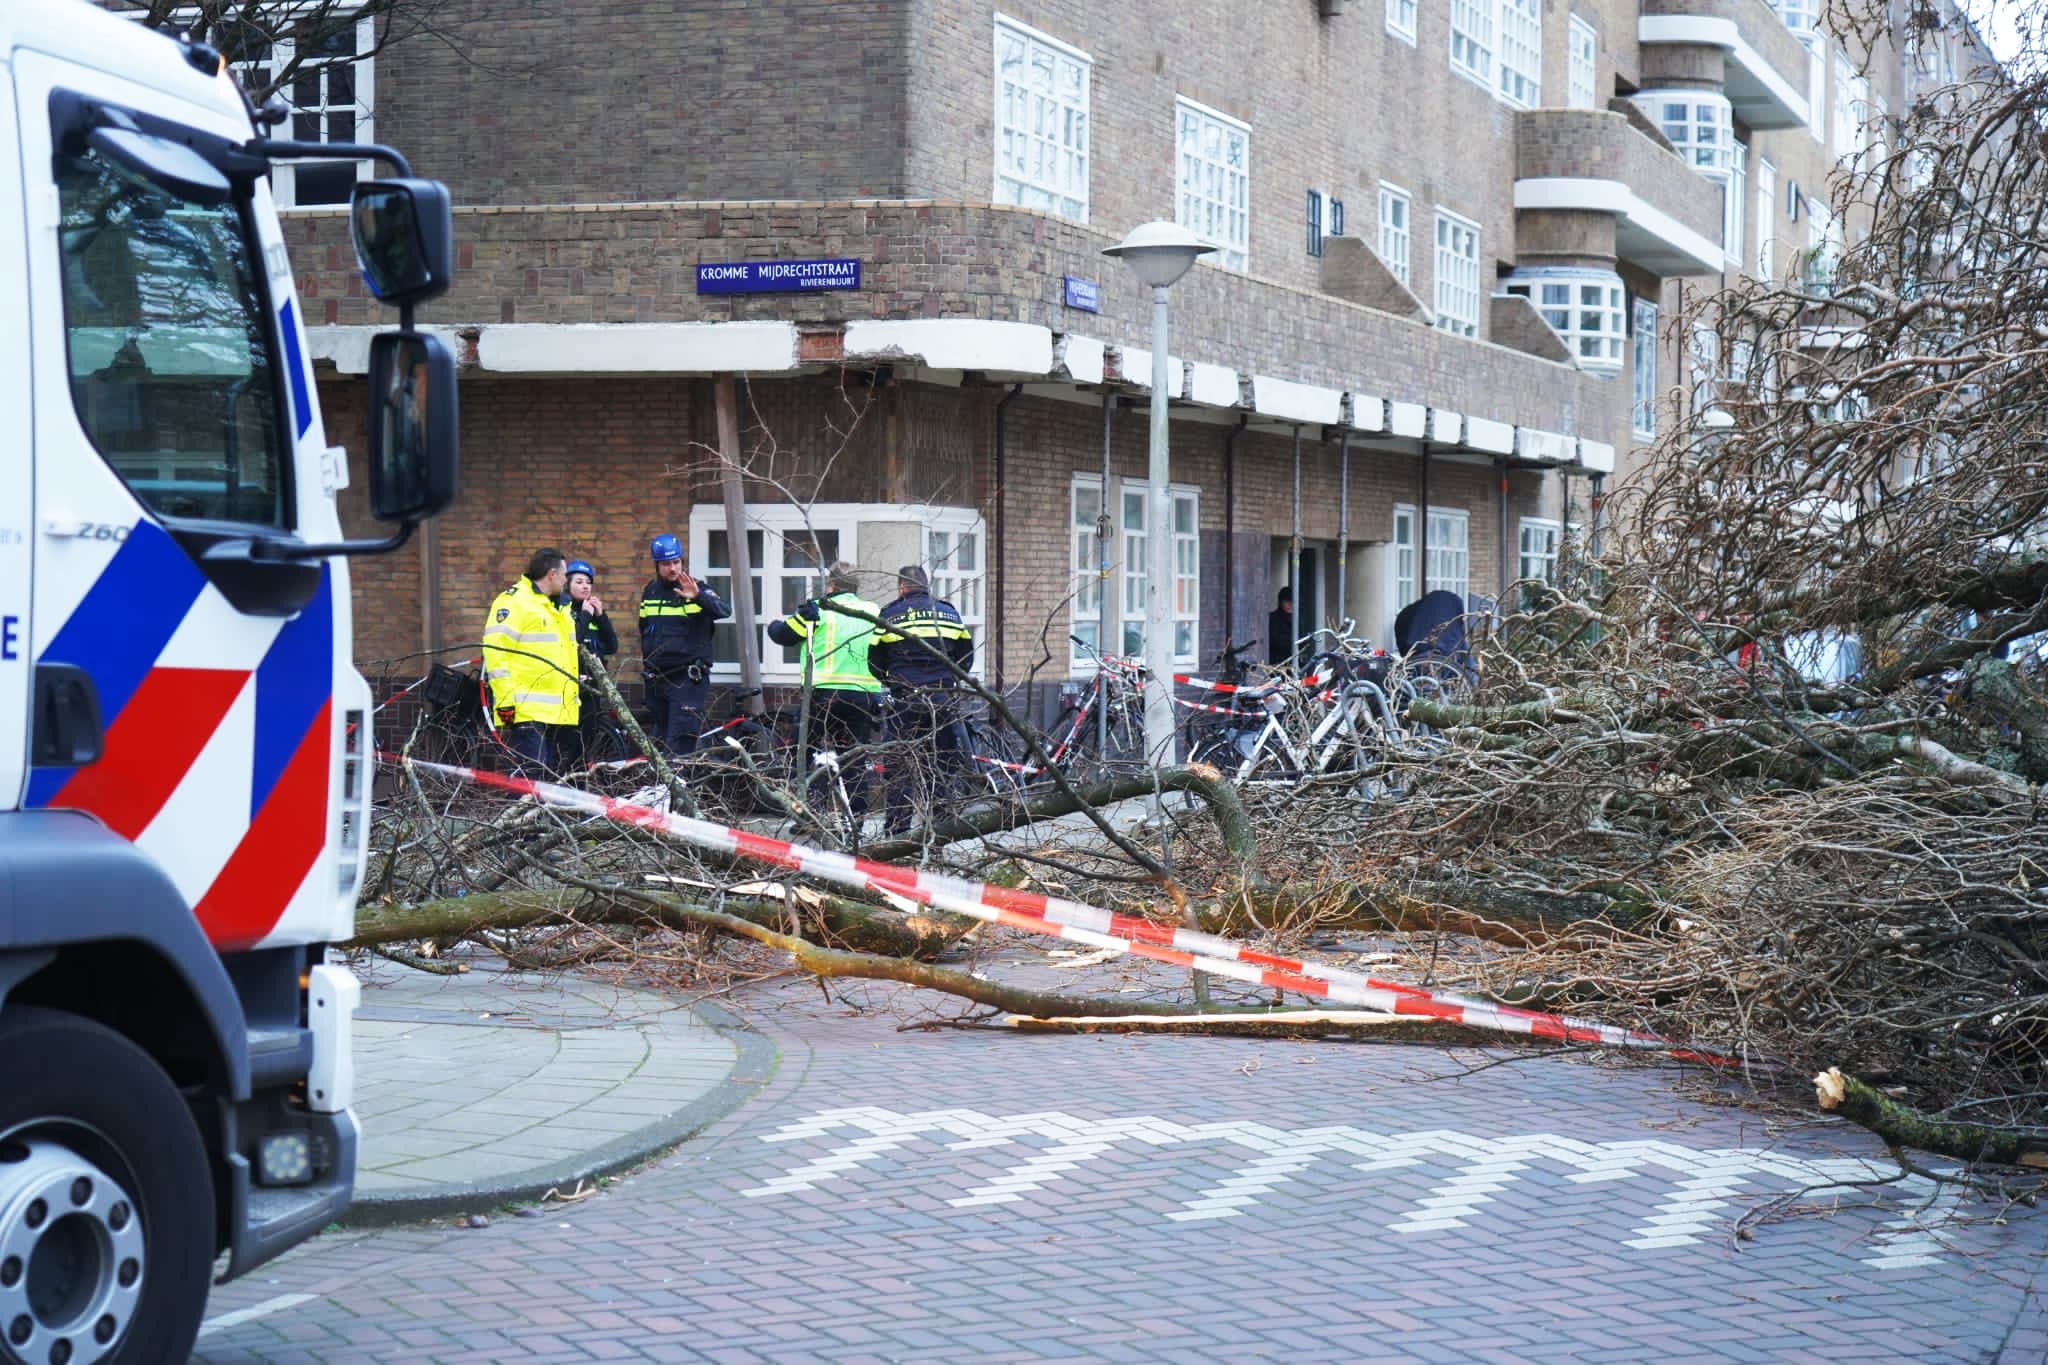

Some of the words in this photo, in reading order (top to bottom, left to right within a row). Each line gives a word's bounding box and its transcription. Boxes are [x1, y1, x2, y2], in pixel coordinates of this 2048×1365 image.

[701, 267, 749, 280] KROMME
[759, 263, 855, 280] MIJDRECHTSTRAAT
[801, 278, 855, 287] RIVIERENBUURT
